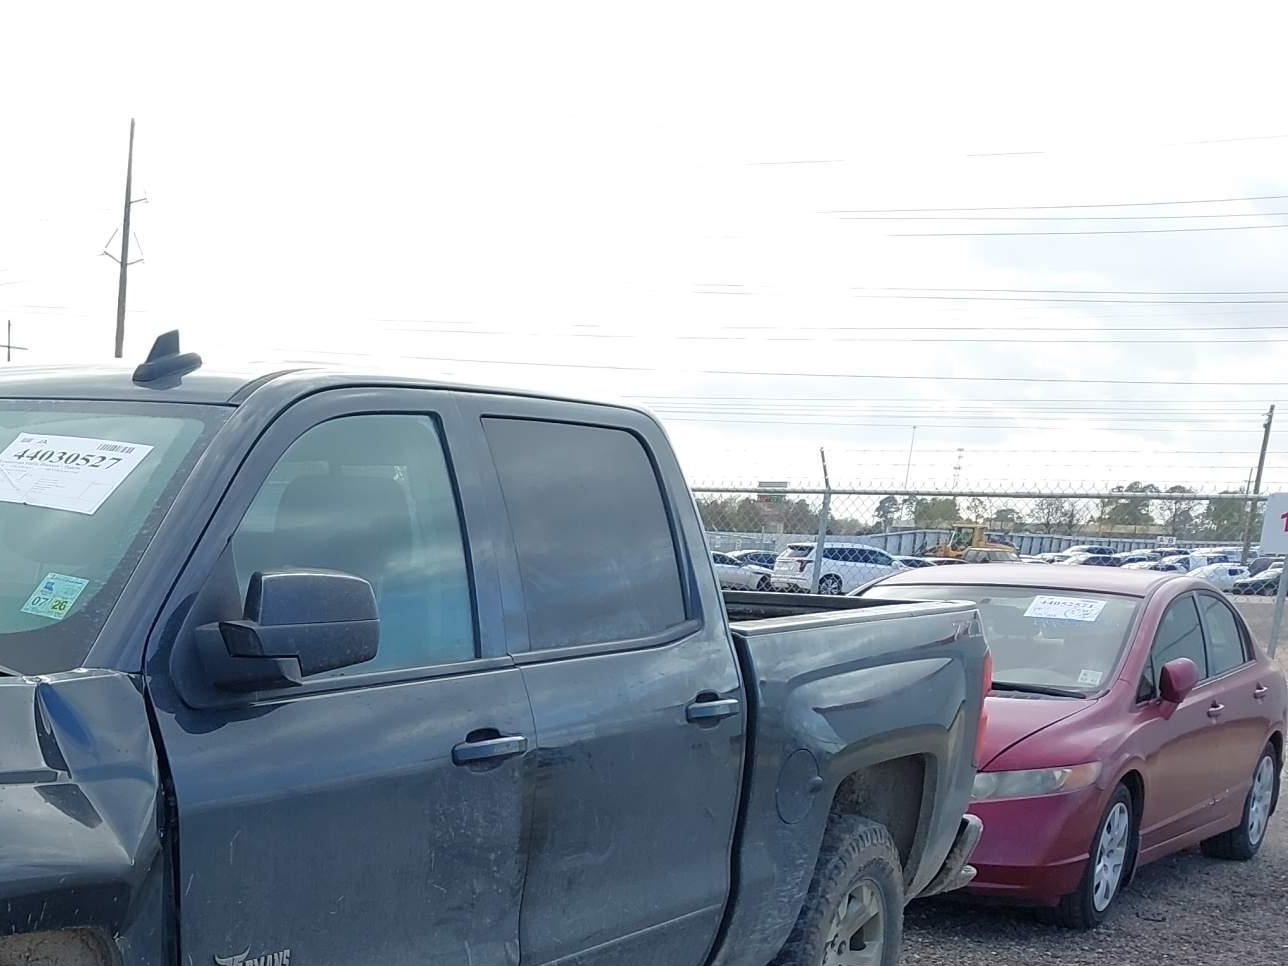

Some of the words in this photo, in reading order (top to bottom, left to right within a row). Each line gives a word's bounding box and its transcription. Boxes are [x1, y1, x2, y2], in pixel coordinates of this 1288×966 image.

[14, 448, 123, 470] 44030527
[32, 596, 49, 606] 07
[51, 600, 68, 611] 26
